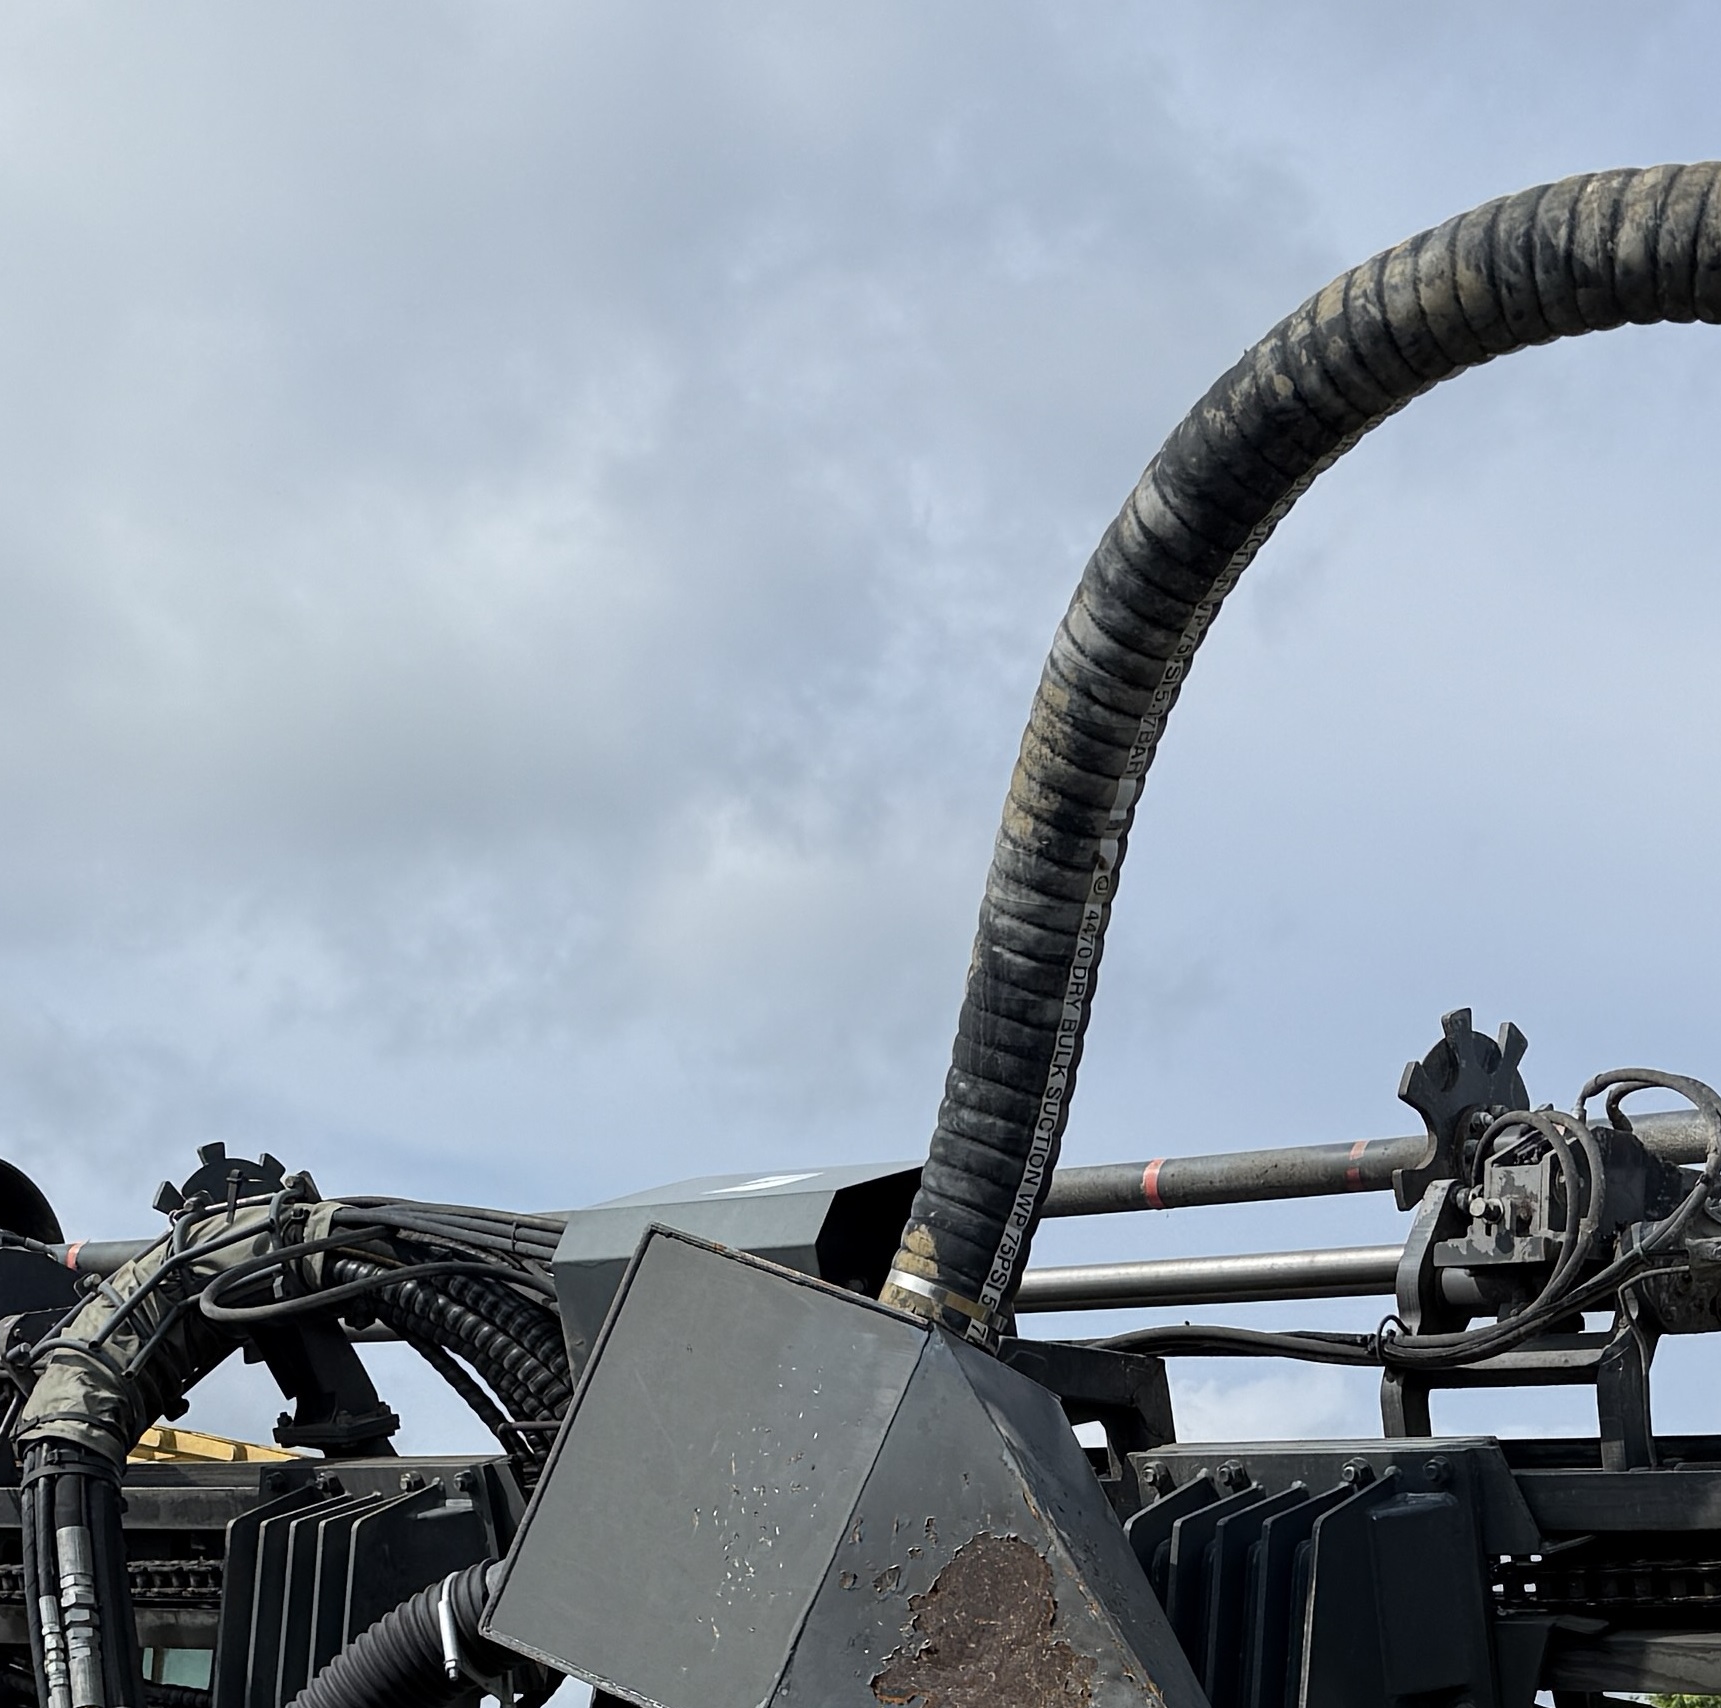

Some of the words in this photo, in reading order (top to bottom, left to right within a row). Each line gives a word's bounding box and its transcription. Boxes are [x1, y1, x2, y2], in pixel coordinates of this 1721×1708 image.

[1126, 690, 1170, 775] 5.17BAR
[1077, 910, 1099, 958] 4470
[1065, 966, 1088, 1011] DRY
[1052, 1018, 1078, 1078] BULK
[1024, 1086, 1063, 1186] SUCTION
[1013, 1193, 1034, 1228] WP
[986, 1231, 1020, 1292] 75PSI
